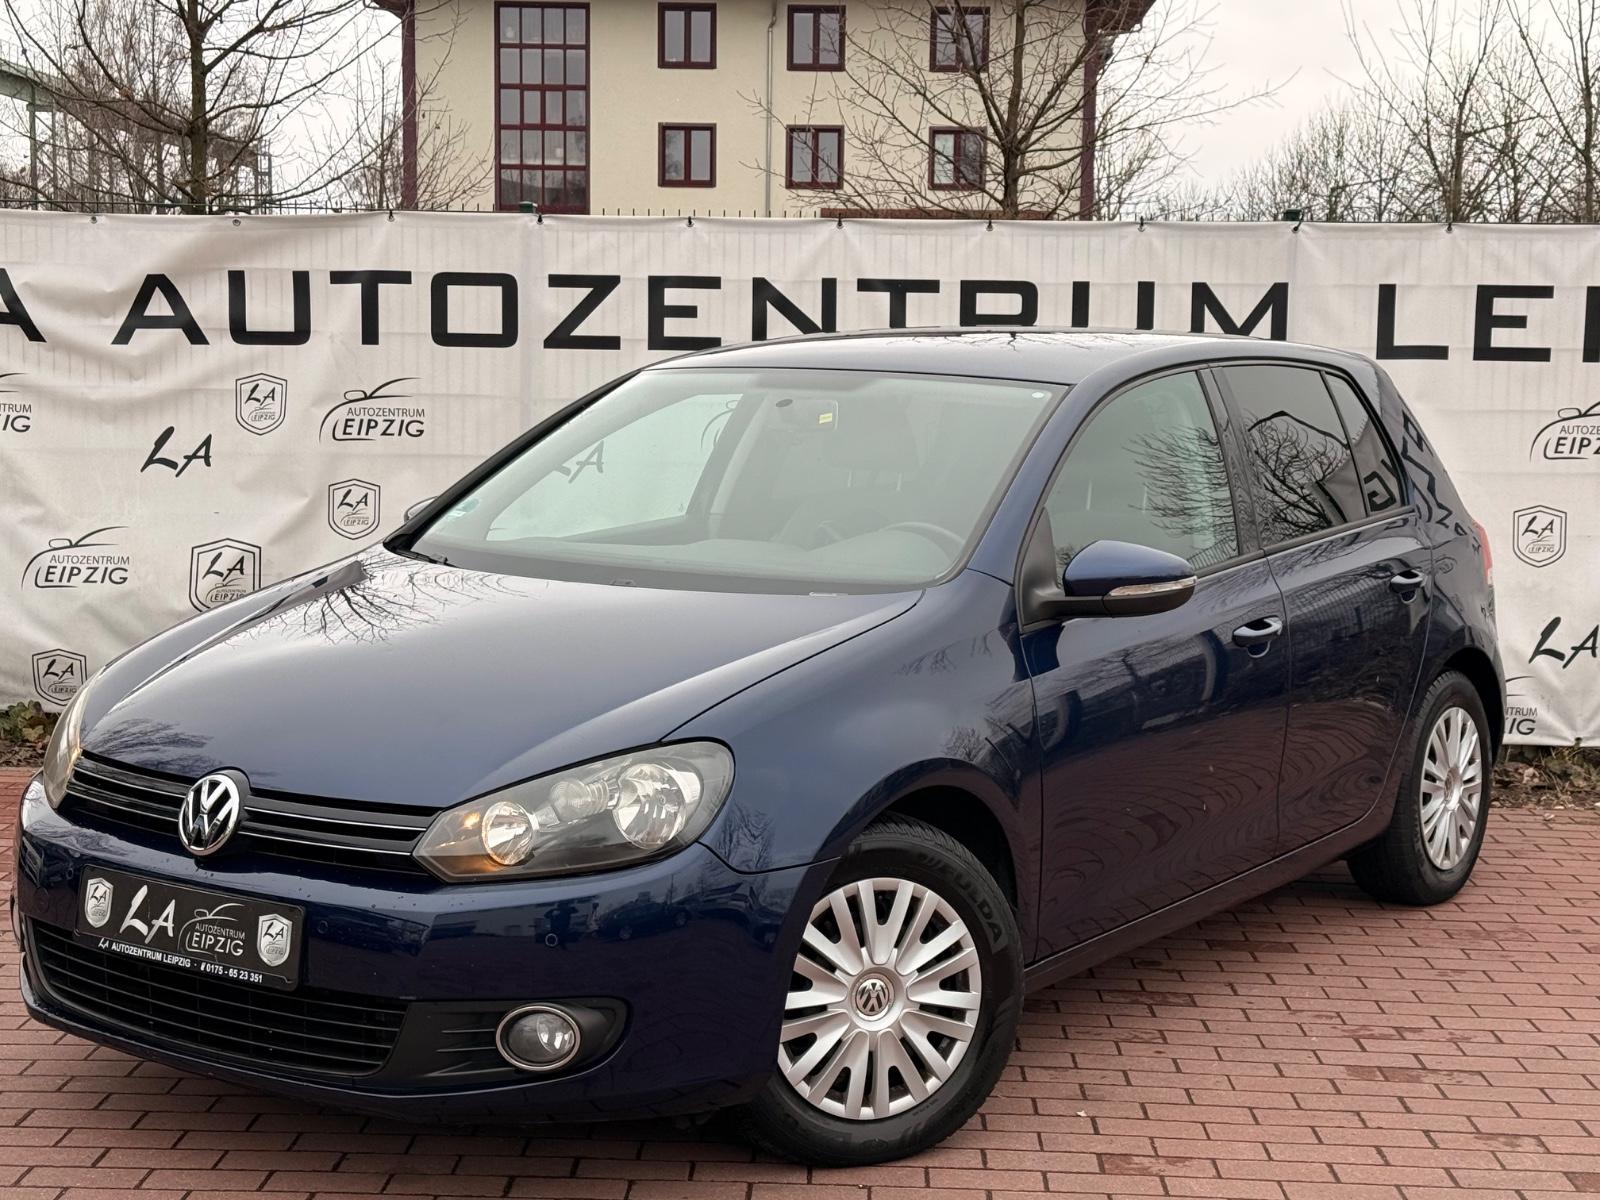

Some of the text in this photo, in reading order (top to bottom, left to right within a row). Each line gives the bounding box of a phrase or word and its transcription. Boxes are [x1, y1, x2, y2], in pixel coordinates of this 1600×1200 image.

[244, 383, 276, 406] LA
[346, 407, 426, 418] AUTOZENTRUM
[140, 426, 213, 478] LA
[337, 489, 369, 511] LA
[1521, 515, 1555, 538] LA
[49, 554, 130, 565] AUTOZENTRUM
[202, 551, 246, 582] LA
[1528, 616, 1600, 669] LA
[42, 658, 75, 680] LA
[90, 885, 107, 903] LA
[119, 884, 176, 944] LA
[195, 922, 246, 940] AUTOZENTRUM
[263, 921, 285, 941] LA
[111, 941, 163, 962] AUTOZENTRUM
[163, 953, 191, 968] LEIPZIG
[206, 963, 223, 975] 0175
[239, 970, 248, 980] 23
[249, 972, 263, 983] 351
